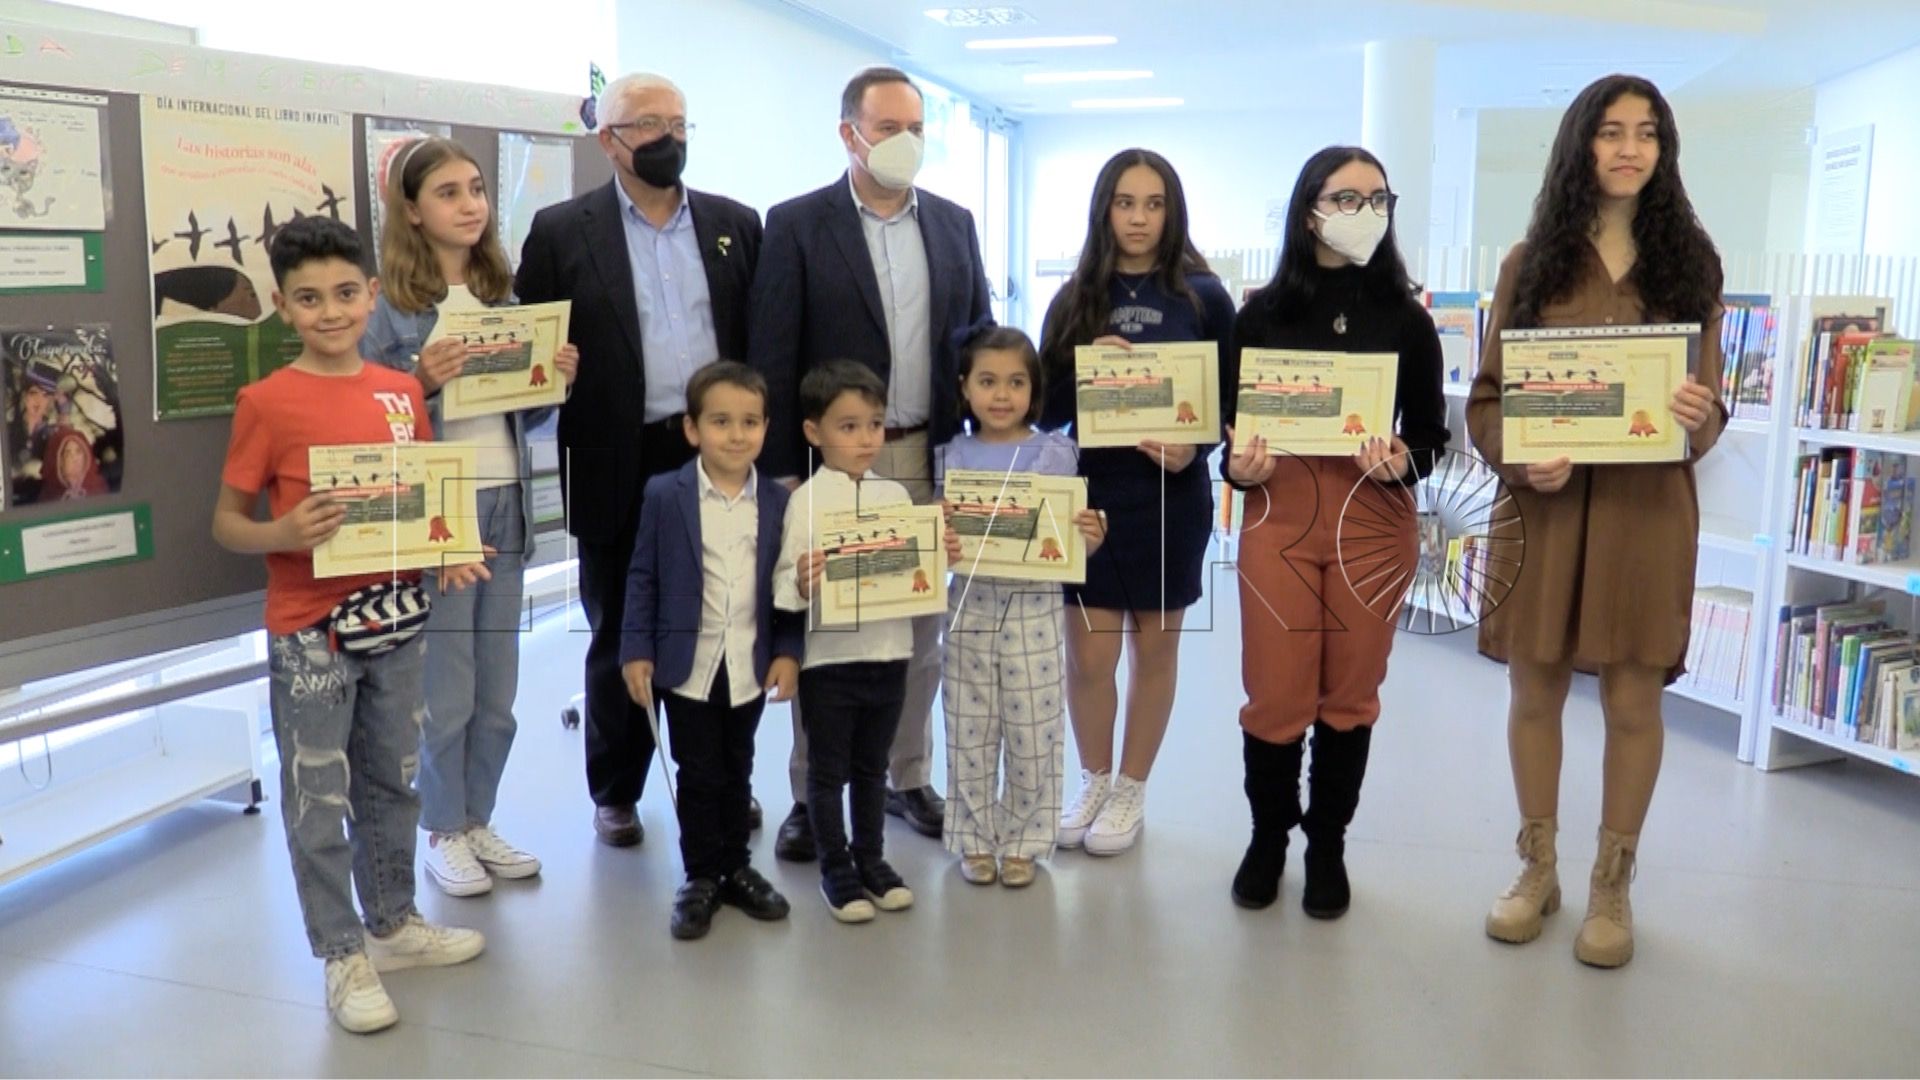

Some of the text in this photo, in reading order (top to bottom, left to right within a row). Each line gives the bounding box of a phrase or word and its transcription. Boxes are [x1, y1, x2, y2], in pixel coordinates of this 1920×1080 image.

[177, 99, 252, 119] INTERNACIONAL
[255, 107, 272, 120] DEL
[274, 109, 301, 122] LIBRO
[302, 112, 341, 127] INFANTIL
[176, 136, 318, 177] Las historias son alas
